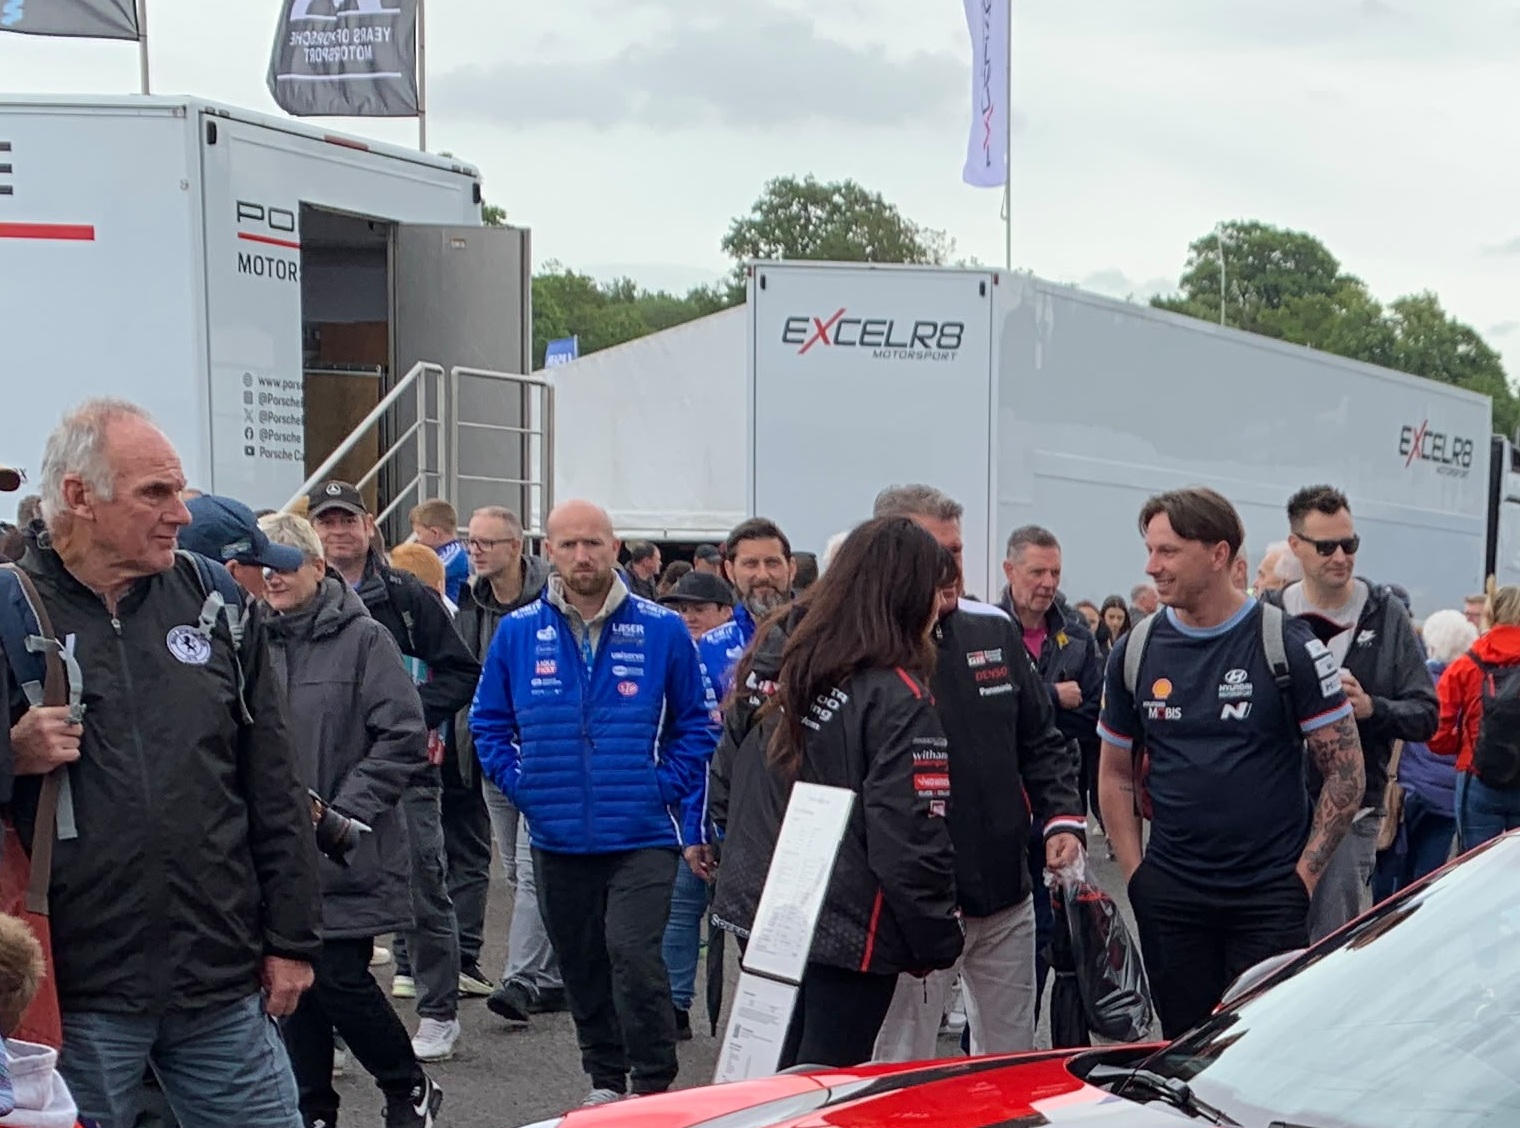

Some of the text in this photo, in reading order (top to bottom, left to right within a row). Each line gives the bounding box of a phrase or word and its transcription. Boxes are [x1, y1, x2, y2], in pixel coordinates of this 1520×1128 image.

[781, 307, 965, 355] EXCELR8
[872, 350, 958, 361] MOTORSPORT
[260, 446, 293, 460] Porsche
[1399, 419, 1473, 467] EXCELR8
